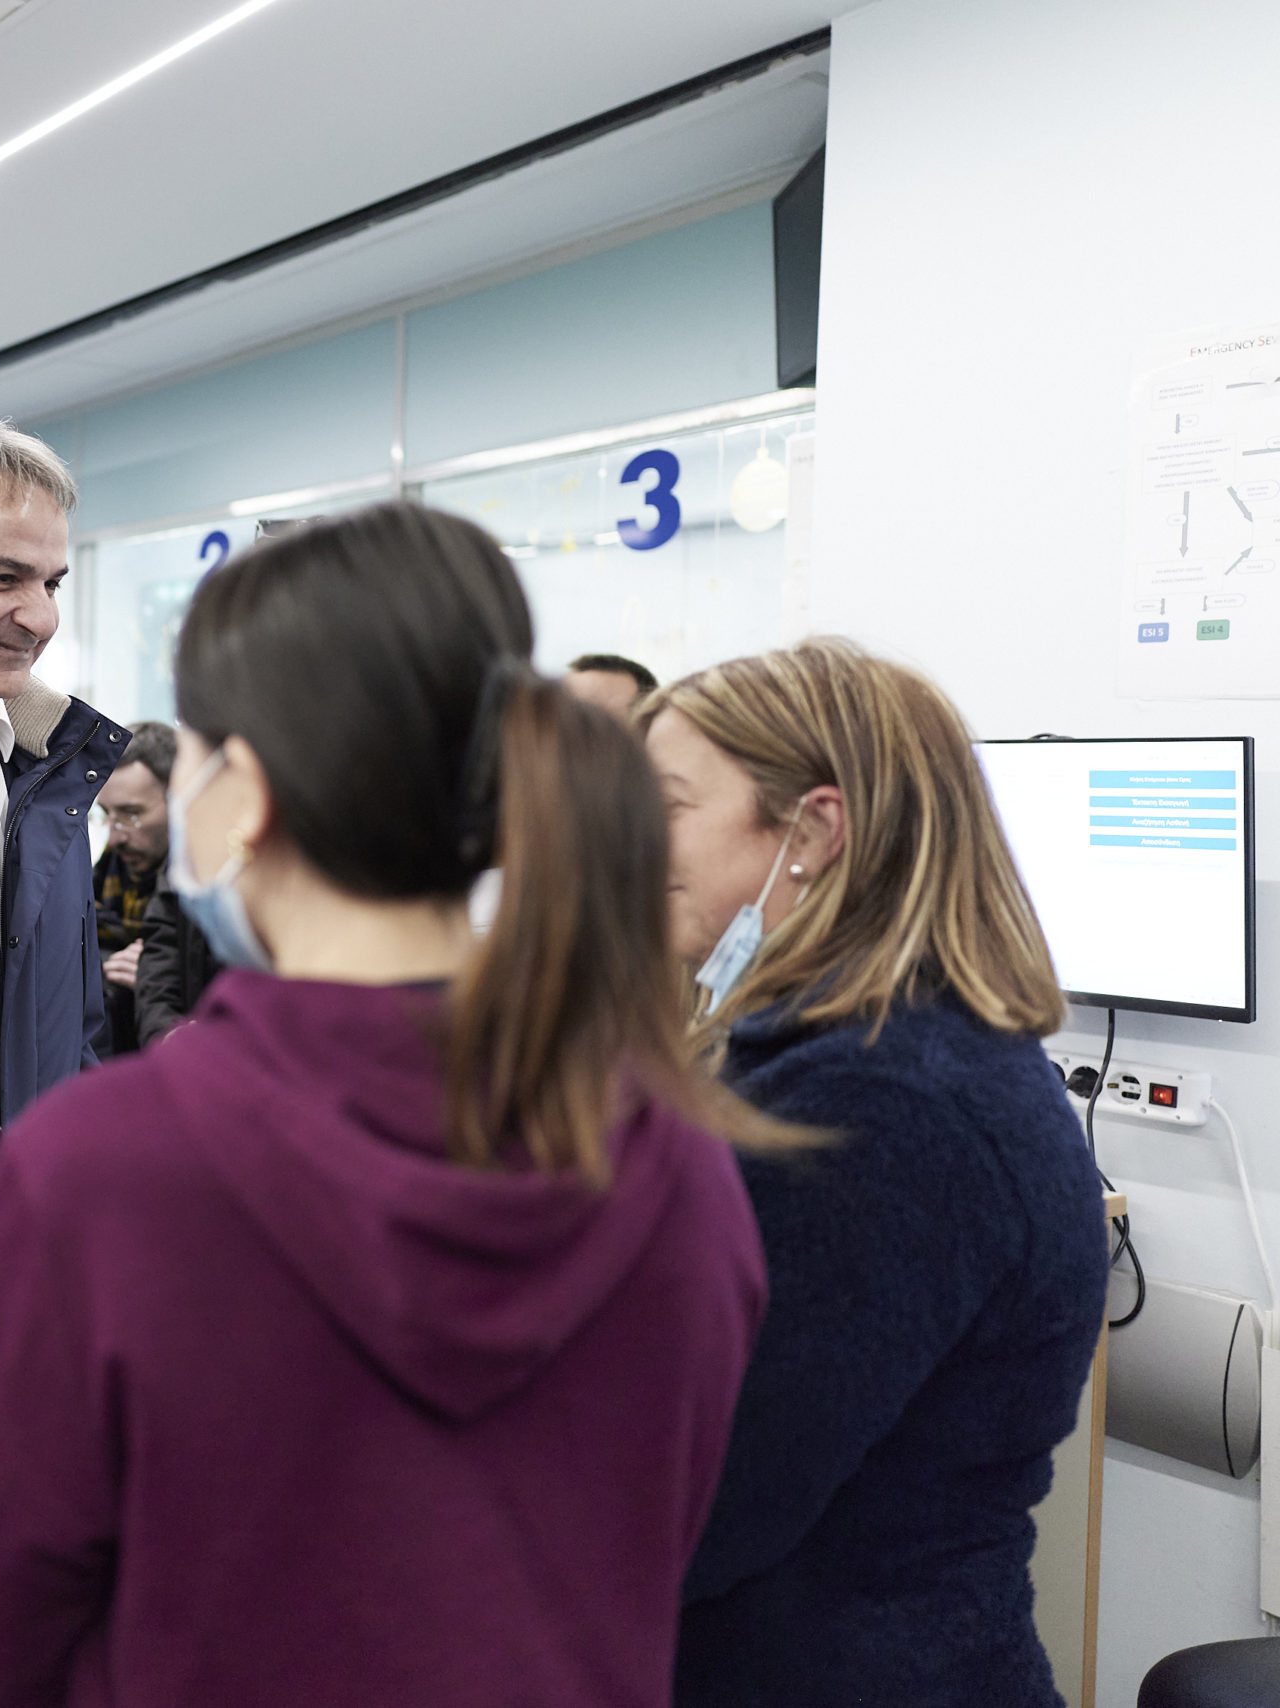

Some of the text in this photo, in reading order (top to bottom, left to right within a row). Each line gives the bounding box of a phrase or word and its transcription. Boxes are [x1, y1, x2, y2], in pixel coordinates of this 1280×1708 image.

[616, 449, 682, 551] 3
[198, 530, 230, 594] 2
[1142, 627, 1164, 637] ESI 5
[1201, 625, 1215, 634] ESI
